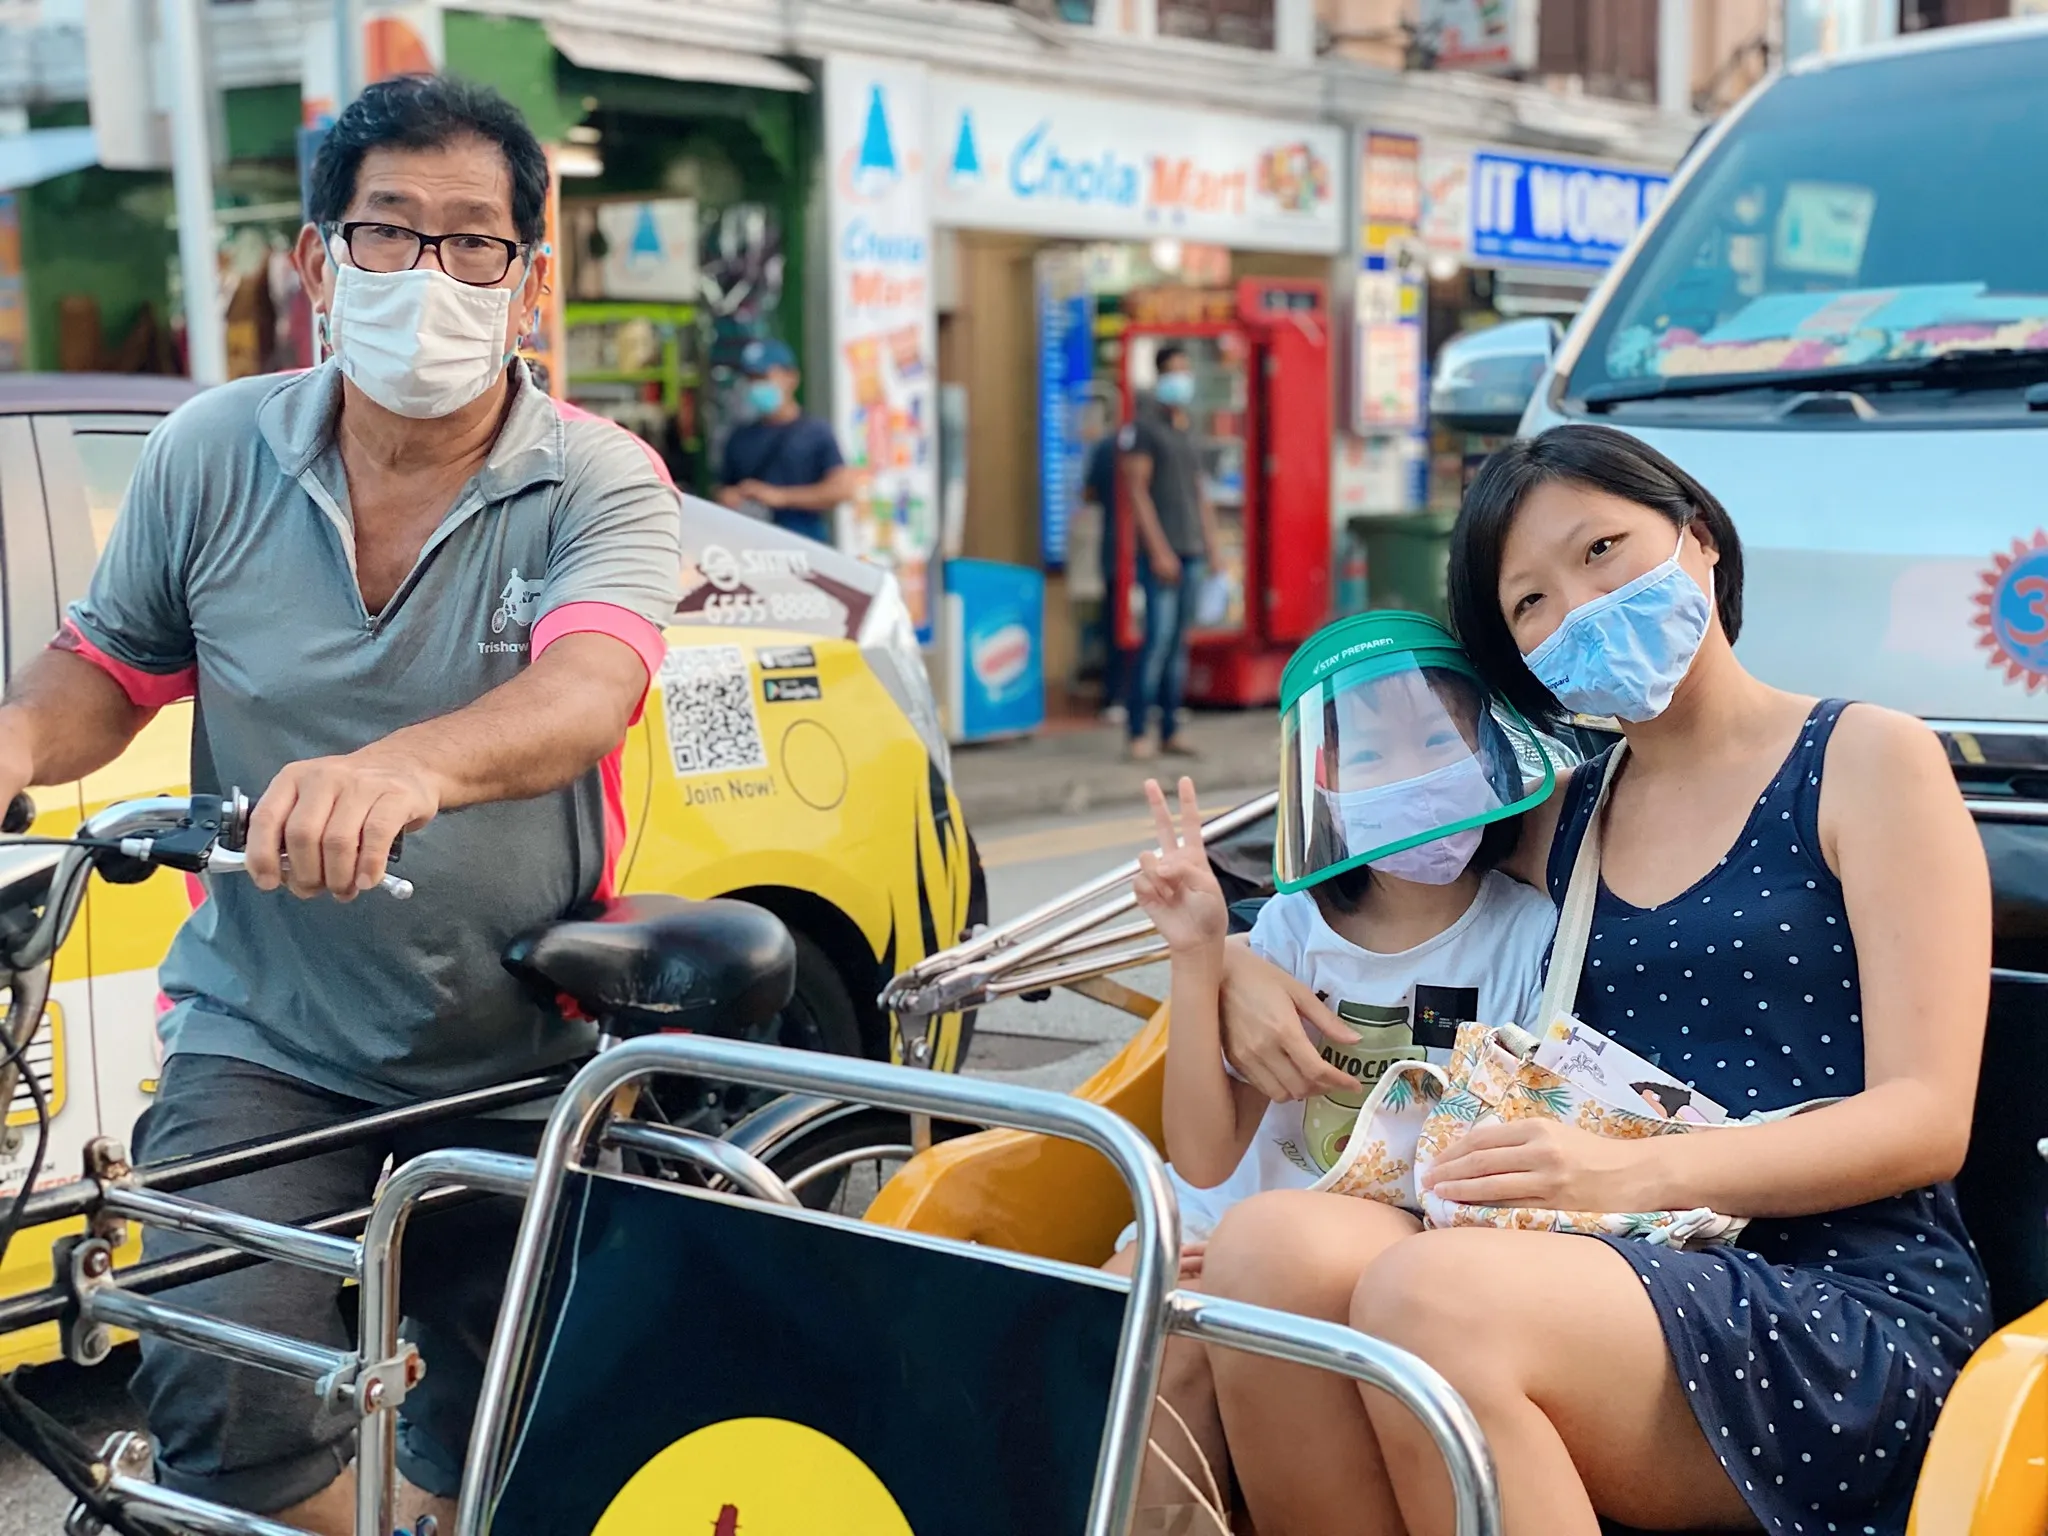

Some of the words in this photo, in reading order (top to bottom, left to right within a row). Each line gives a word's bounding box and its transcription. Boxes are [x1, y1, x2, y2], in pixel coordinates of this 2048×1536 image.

[1150, 155, 1246, 216] Mart
[1476, 156, 1524, 235] IT
[703, 593, 767, 624] 6555
[478, 641, 529, 654] Trishaw
[1319, 653, 1340, 672] STAY
[1341, 637, 1394, 659] PREPARED
[685, 783, 726, 806] Join
[728, 775, 778, 802] Now!
